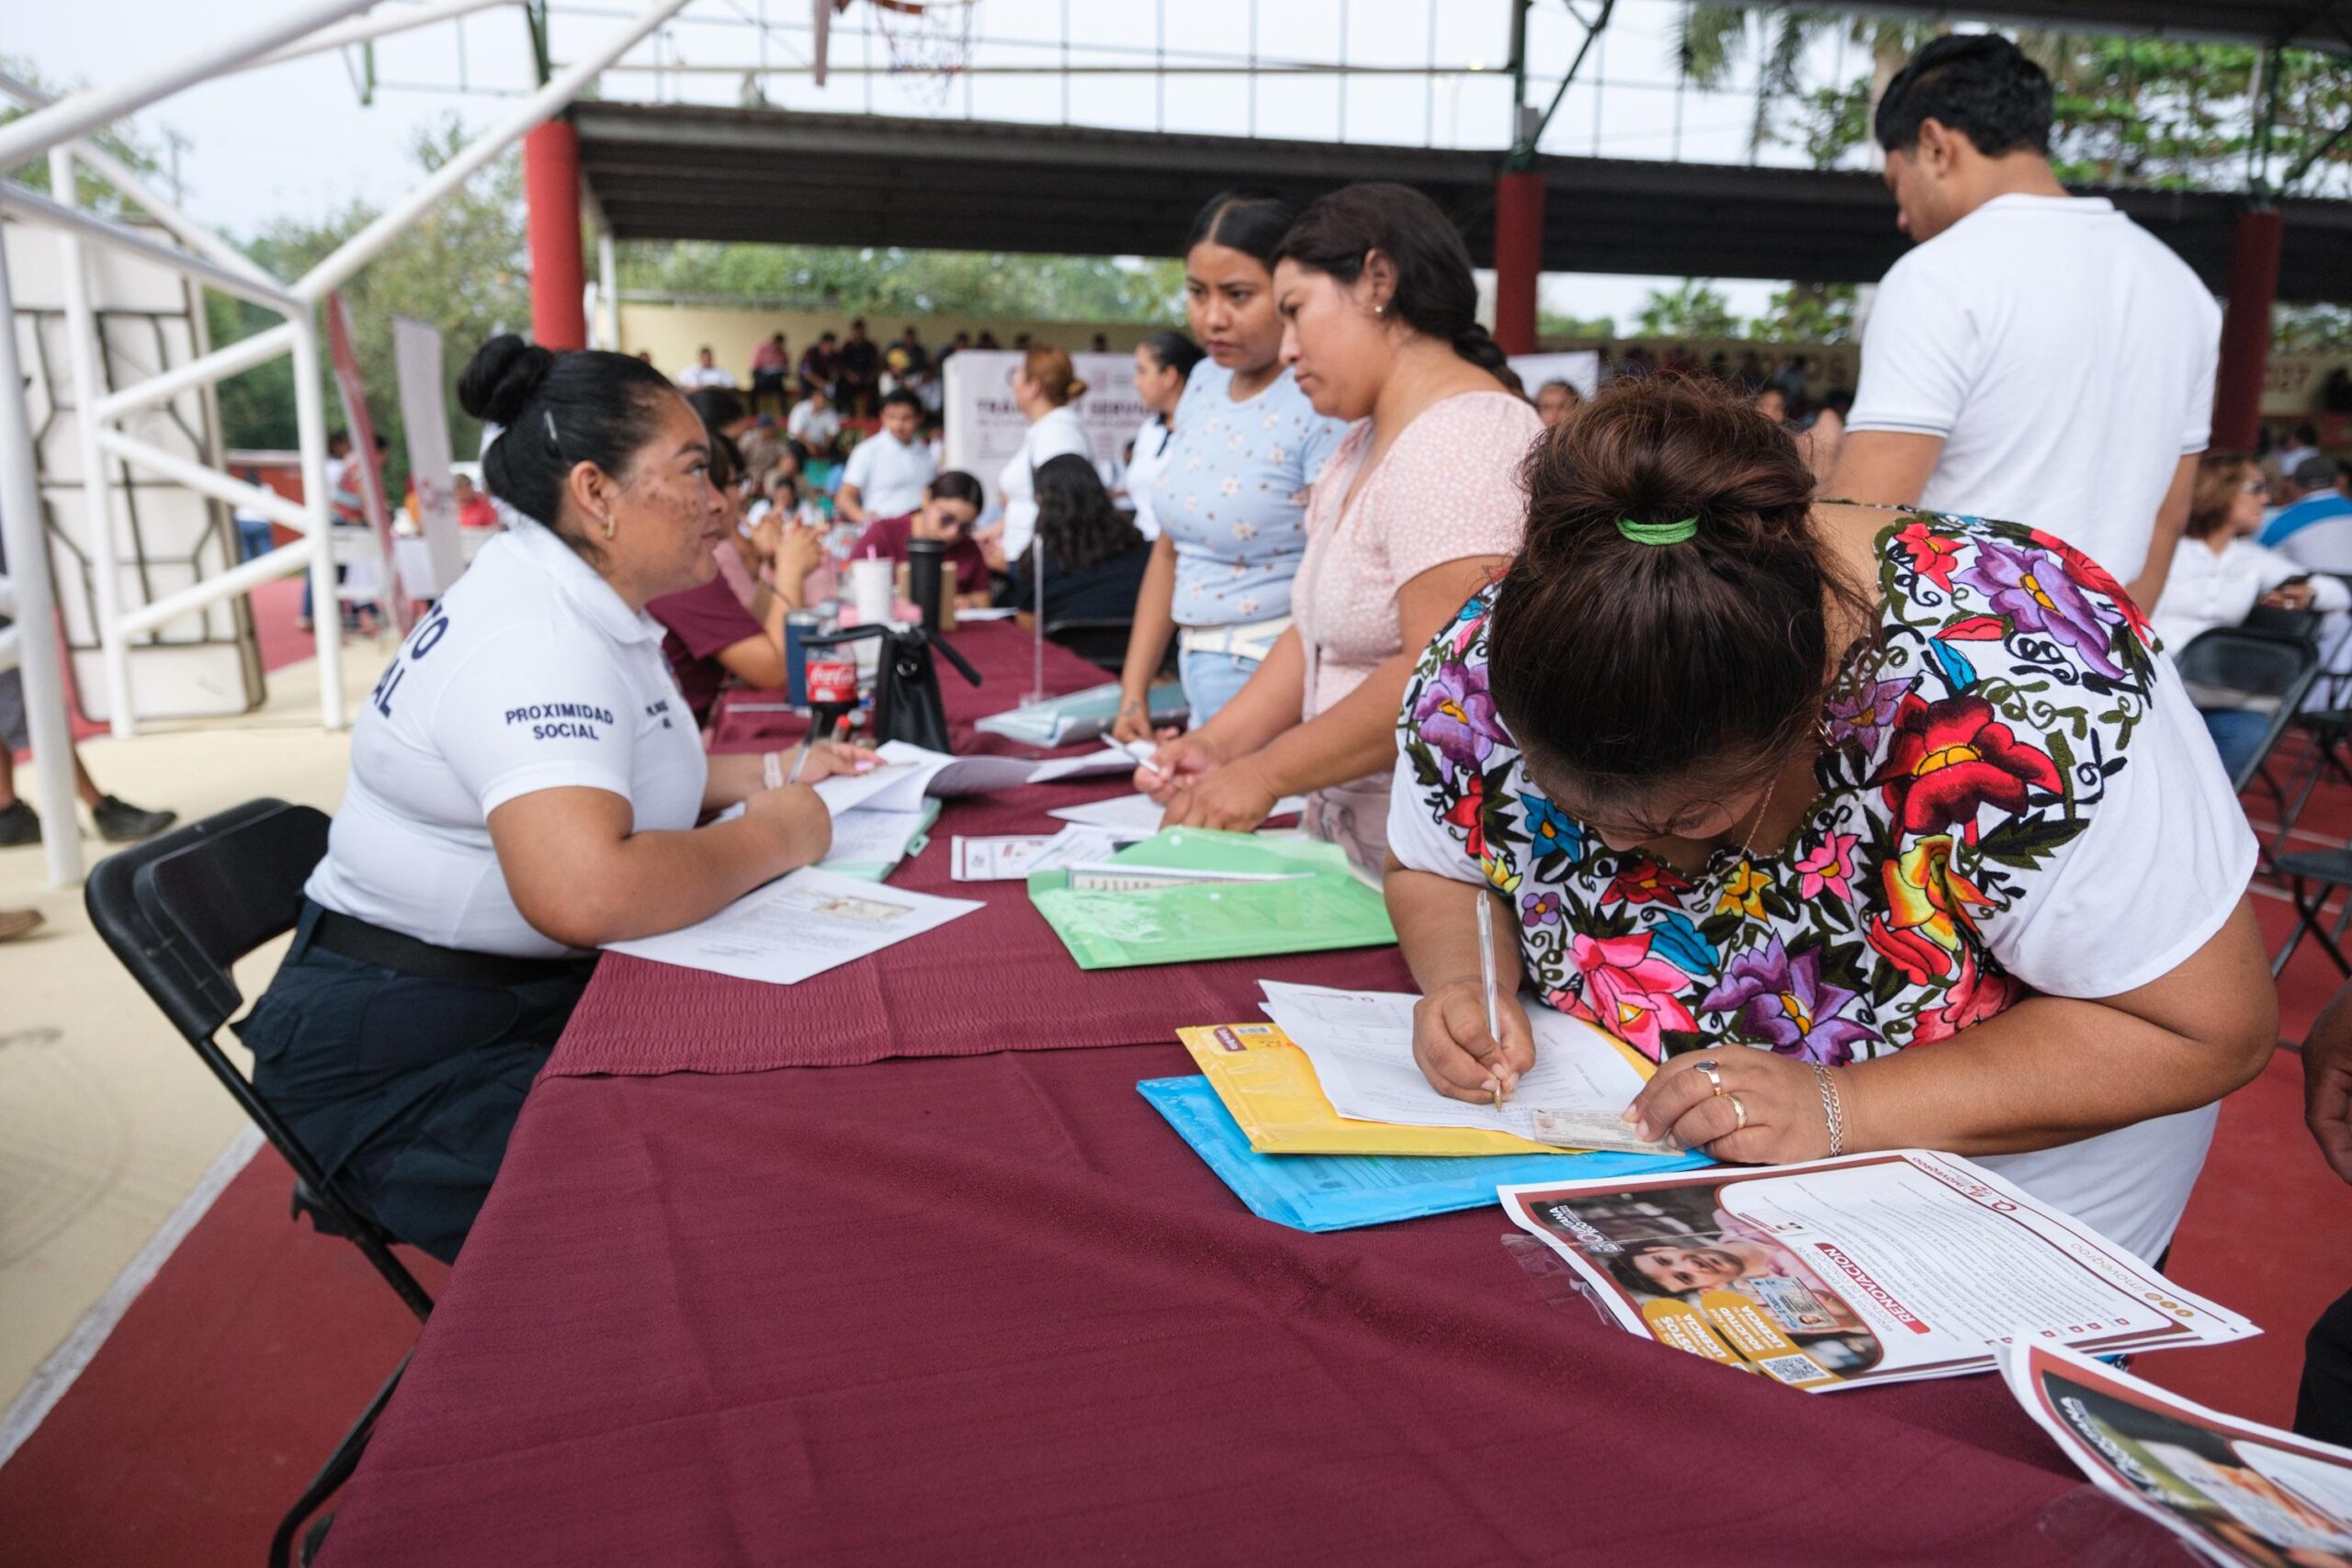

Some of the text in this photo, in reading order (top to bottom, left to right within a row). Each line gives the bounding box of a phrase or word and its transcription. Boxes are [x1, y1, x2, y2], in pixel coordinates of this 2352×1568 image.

[505, 703, 615, 725] PROXIMIDAD
[533, 723, 599, 740] SOCIAL
[2069, 1241, 2146, 1294] imoveqroo
[1661, 1315, 1701, 1356] OSTOS
[1682, 1313, 1726, 1358] LICENCIA
[1719, 1306, 1764, 1351] SOLICITUD
[1740, 1305, 1787, 1348] LICENCIA
